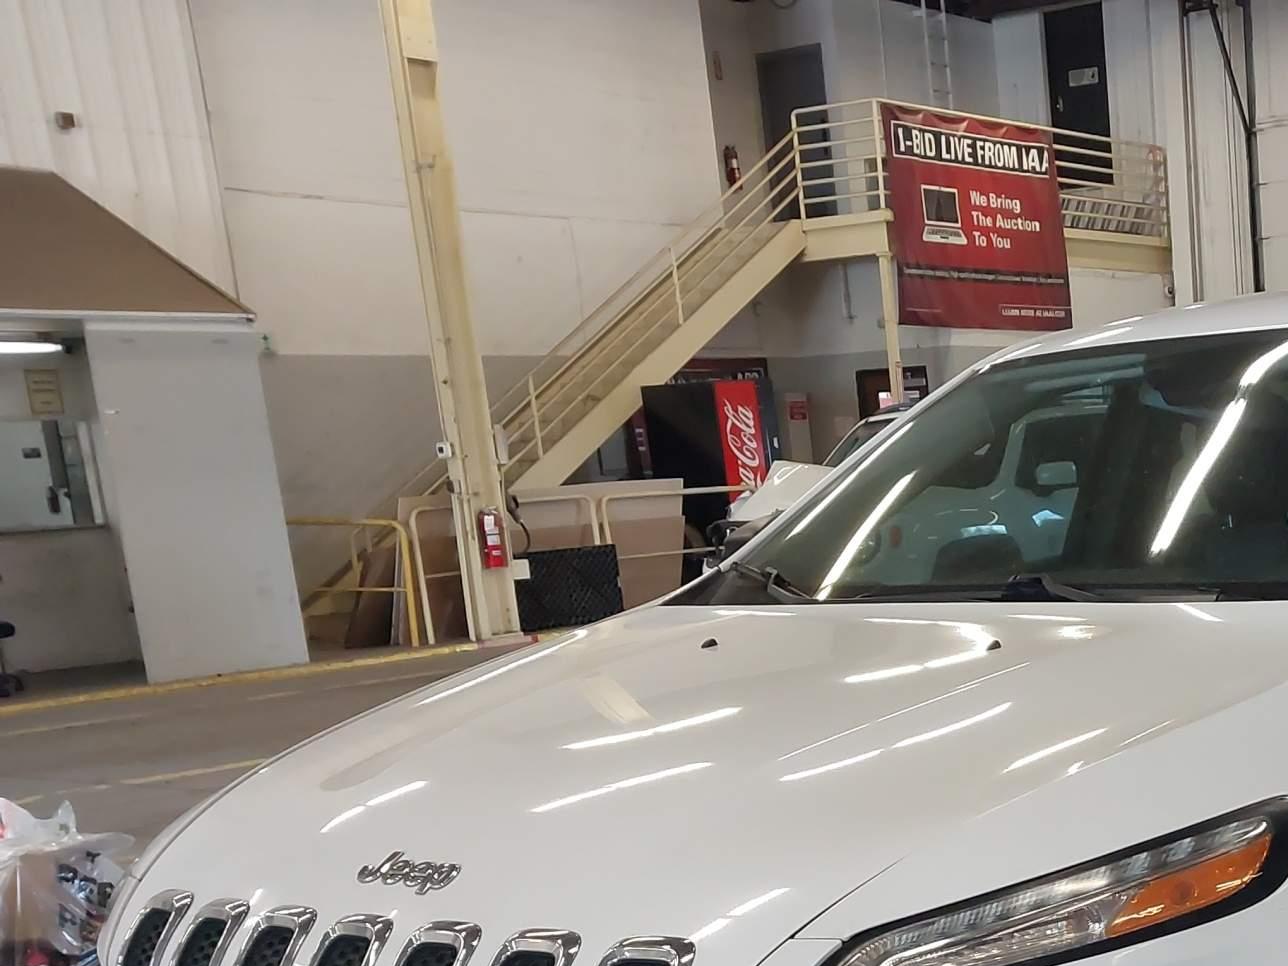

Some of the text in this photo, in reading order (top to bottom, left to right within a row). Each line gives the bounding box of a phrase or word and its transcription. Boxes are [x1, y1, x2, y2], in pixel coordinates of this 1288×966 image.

[898, 127, 936, 157] I-BID
[941, 135, 974, 163] LIVE
[976, 140, 1018, 170] FROM
[969, 190, 1020, 213] We Bring
[971, 211, 1040, 232] The Auction
[973, 231, 1011, 249] To You
[357, 850, 462, 895] Jeep
